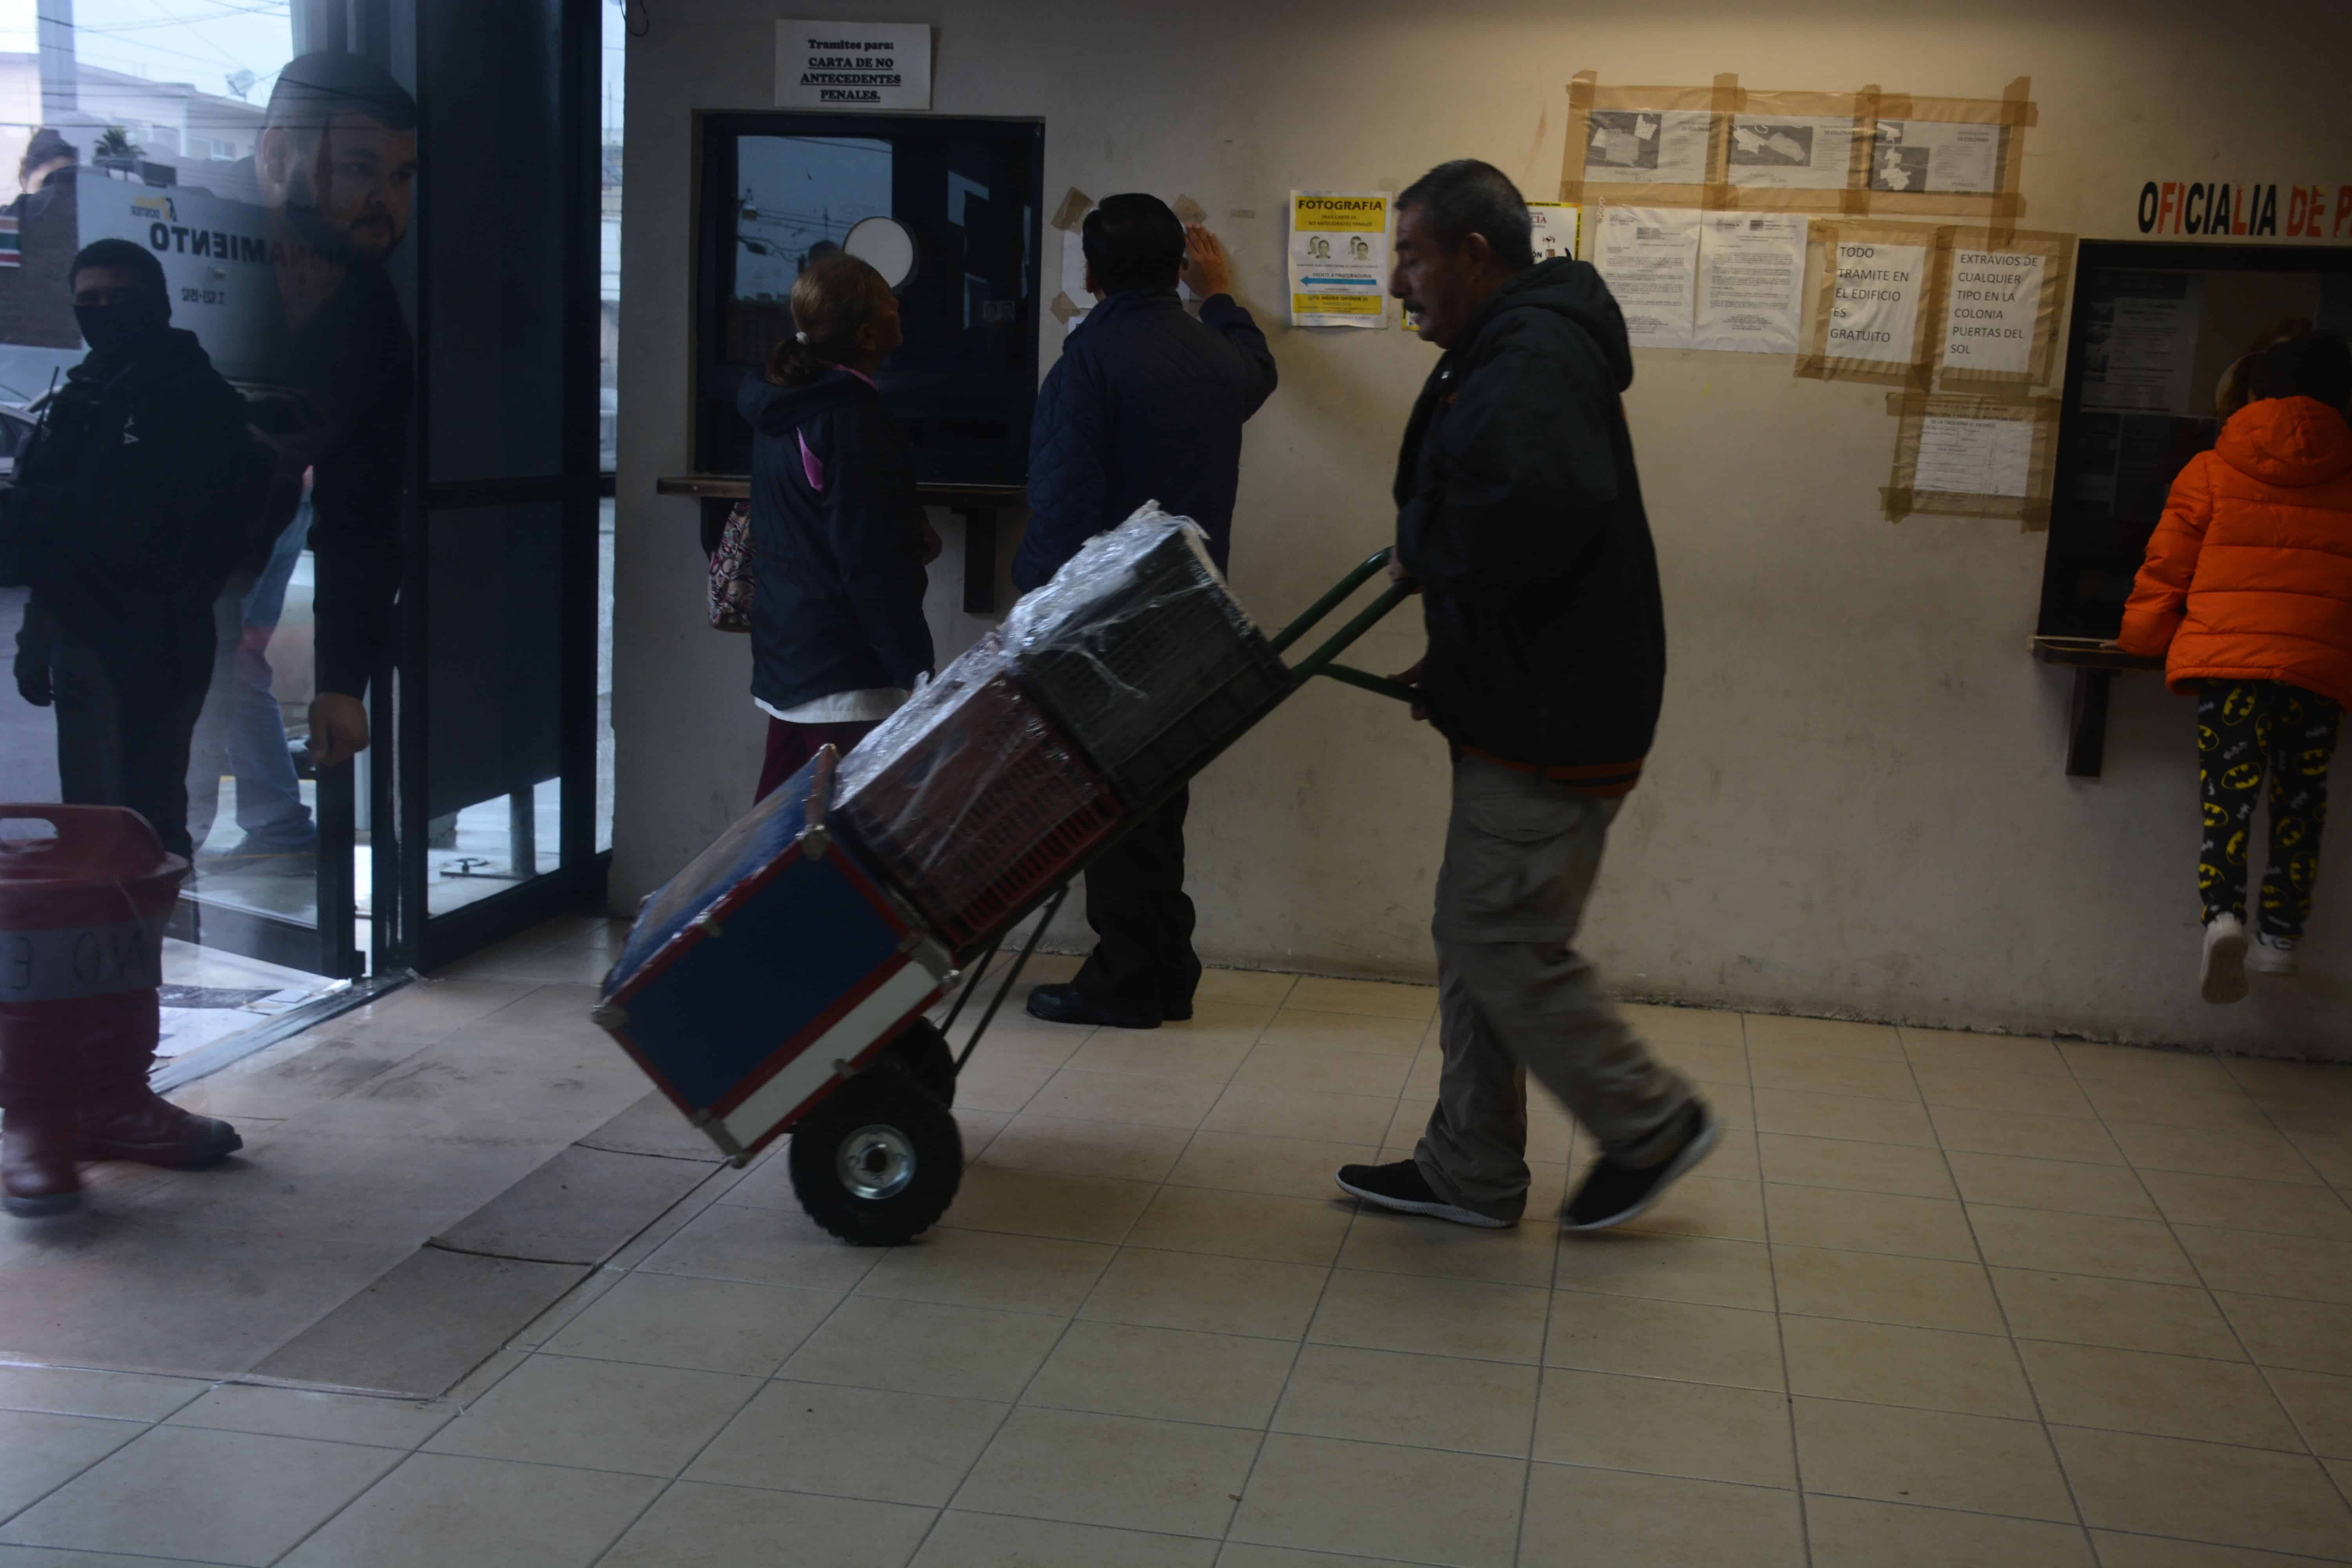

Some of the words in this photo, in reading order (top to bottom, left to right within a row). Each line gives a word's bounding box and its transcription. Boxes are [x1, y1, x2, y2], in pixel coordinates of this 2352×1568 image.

[808, 39, 861, 50] Tramites
[864, 41, 894, 52] para:
[808, 57, 853, 68] CARTA
[855, 58, 873, 68] DE
[875, 58, 894, 68] NO
[800, 73, 901, 84] ANTECEDENTES
[820, 90, 881, 101] PENALES.
[1298, 200, 1383, 211] FOTOGRAFIA
[2138, 181, 2277, 236] OFICIALIA
[2286, 184, 2325, 237] DE
[2333, 185, 2352, 238] P
[1840, 247, 1874, 258] TODO
[1960, 254, 2020, 266] EXTRAVIOS
[2023, 256, 2038, 267] DE
[1837, 268, 1889, 281] TRAMITE
[1893, 272, 1909, 282] EN
[1958, 272, 2021, 285] CUALQUIER
[1835, 288, 1848, 299] EL
[1851, 289, 1901, 301] EDIFICIO
[1956, 290, 1981, 301] TIPO
[1984, 291, 1998, 301] EN
[2002, 292, 2015, 302] LA
[1833, 307, 1847, 317] ES
[1954, 308, 2004, 320] COLONIA
[1830, 328, 1891, 343] GRATUITO
[1952, 327, 2001, 338] PUERTAS
[2004, 328, 2024, 339] DEL
[1950, 344, 1970, 354] SOL
